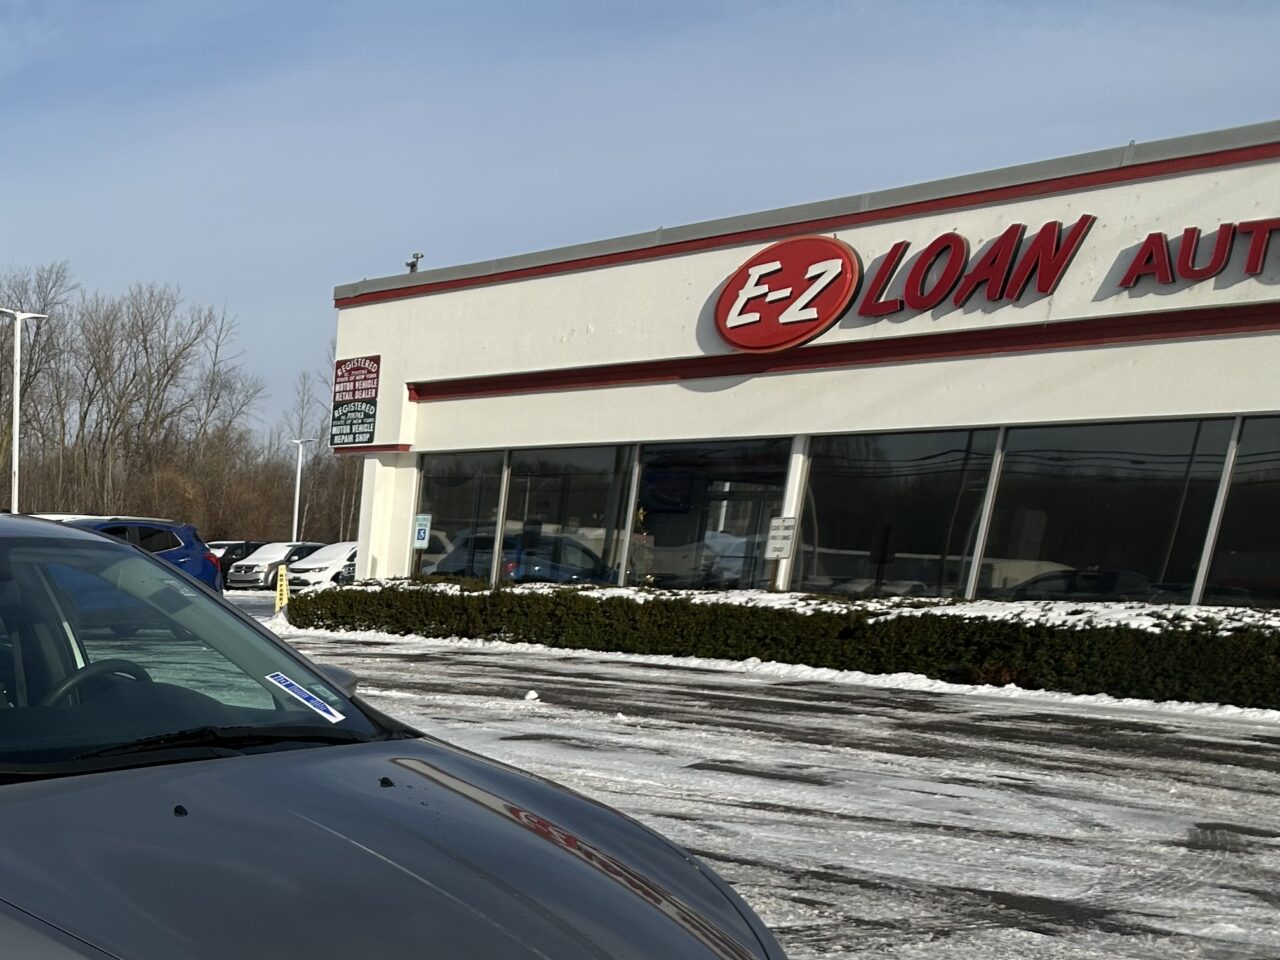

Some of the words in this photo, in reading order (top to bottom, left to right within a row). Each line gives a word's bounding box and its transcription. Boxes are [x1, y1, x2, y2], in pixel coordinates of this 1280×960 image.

[726, 258, 843, 328] E-Z
[858, 214, 1097, 316] LOAN
[1119, 217, 1280, 288] AUT
[337, 358, 378, 376] REGISTERED
[335, 382, 354, 392] MOTOR
[355, 379, 378, 390] VEHICLE
[335, 391, 354, 401] RETAIL
[355, 389, 376, 399] DEALER
[334, 402, 375, 418] REGISTERED
[332, 425, 351, 435] MOTOR
[352, 423, 375, 433] VEHICLE
[333, 434, 354, 444] REPAIR
[355, 433, 371, 442] SHOP
